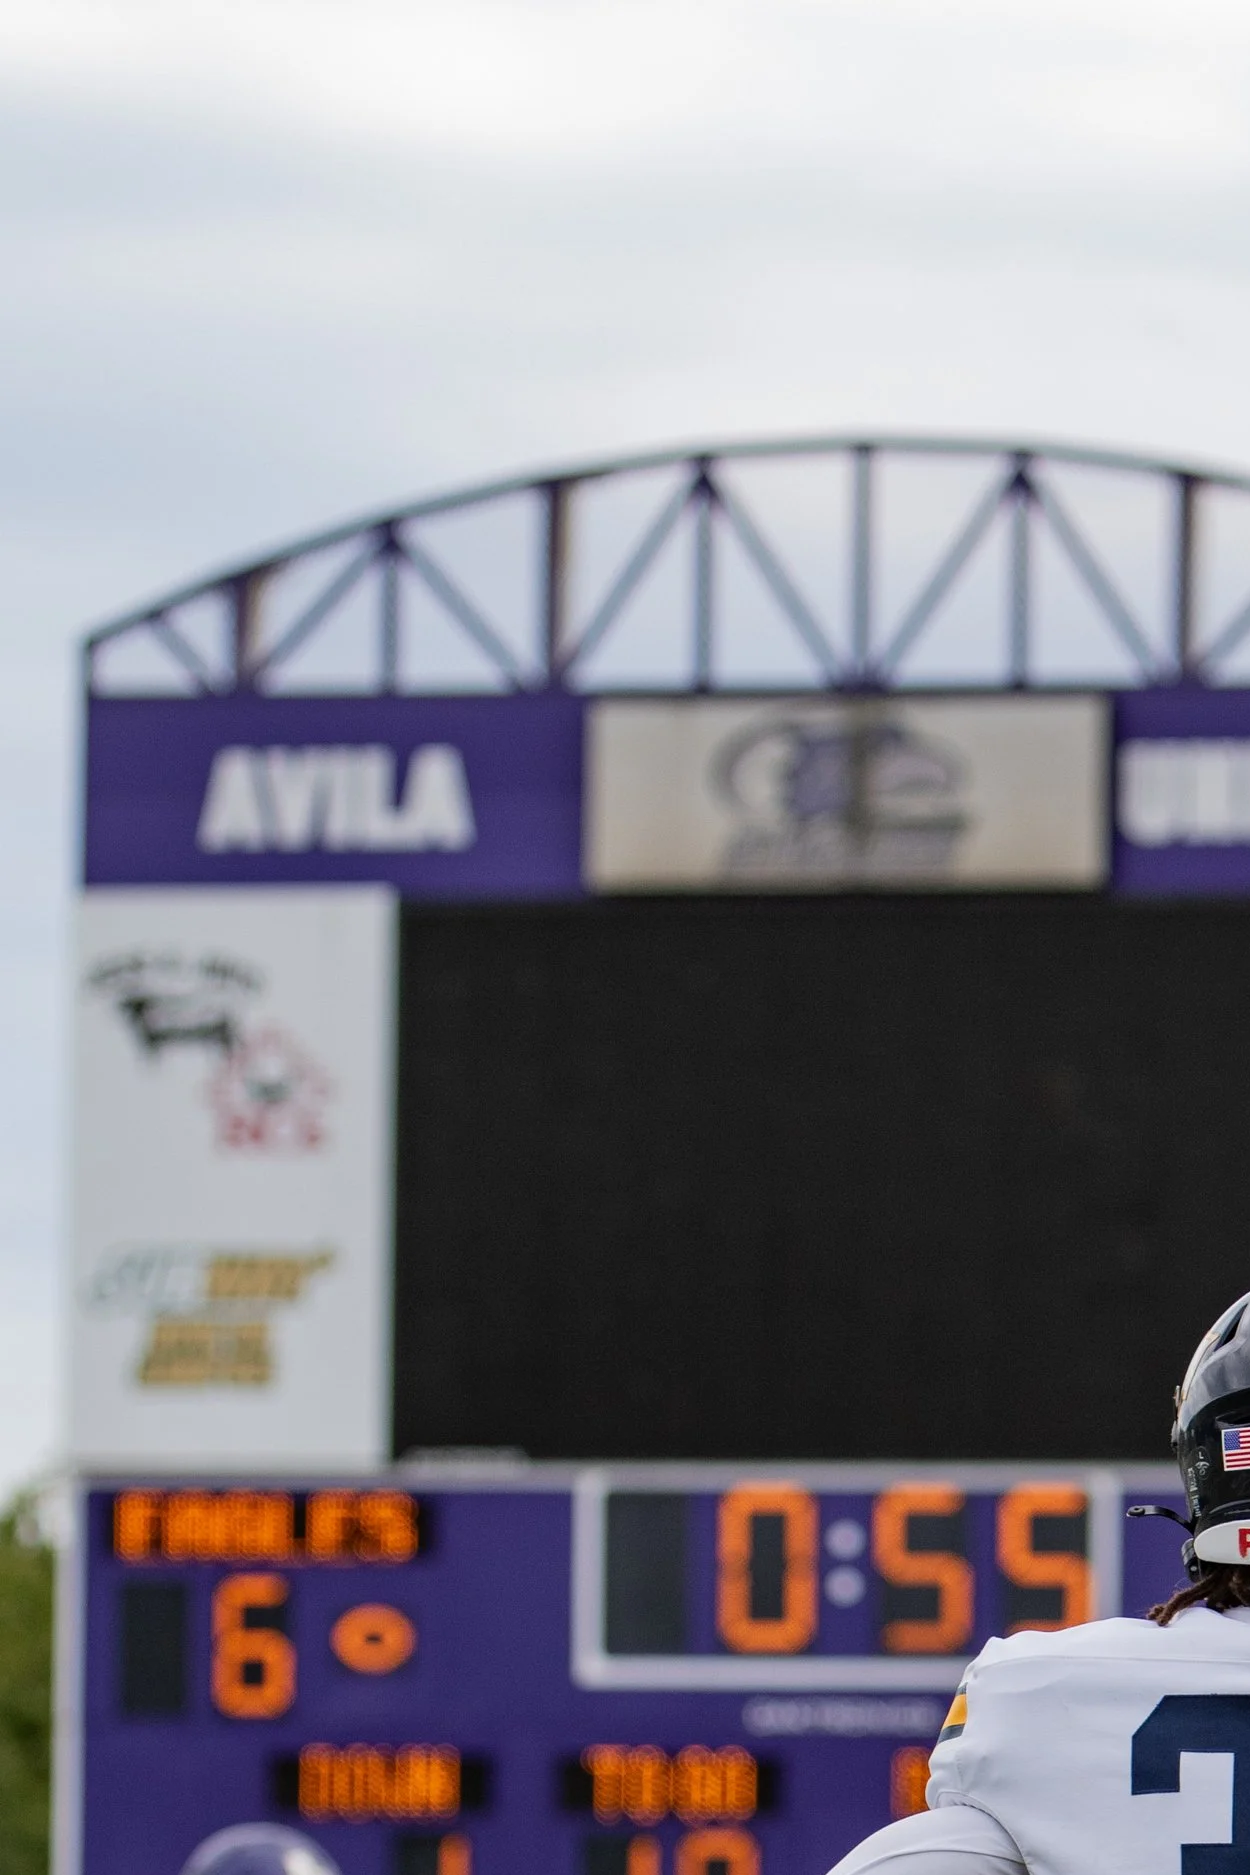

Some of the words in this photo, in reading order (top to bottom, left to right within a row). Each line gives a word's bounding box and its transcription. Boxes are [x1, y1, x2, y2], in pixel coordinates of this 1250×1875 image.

[198, 743, 477, 852] AVILA
[716, 1482, 1091, 1653] 0:55
[211, 1573, 296, 1719] 6
